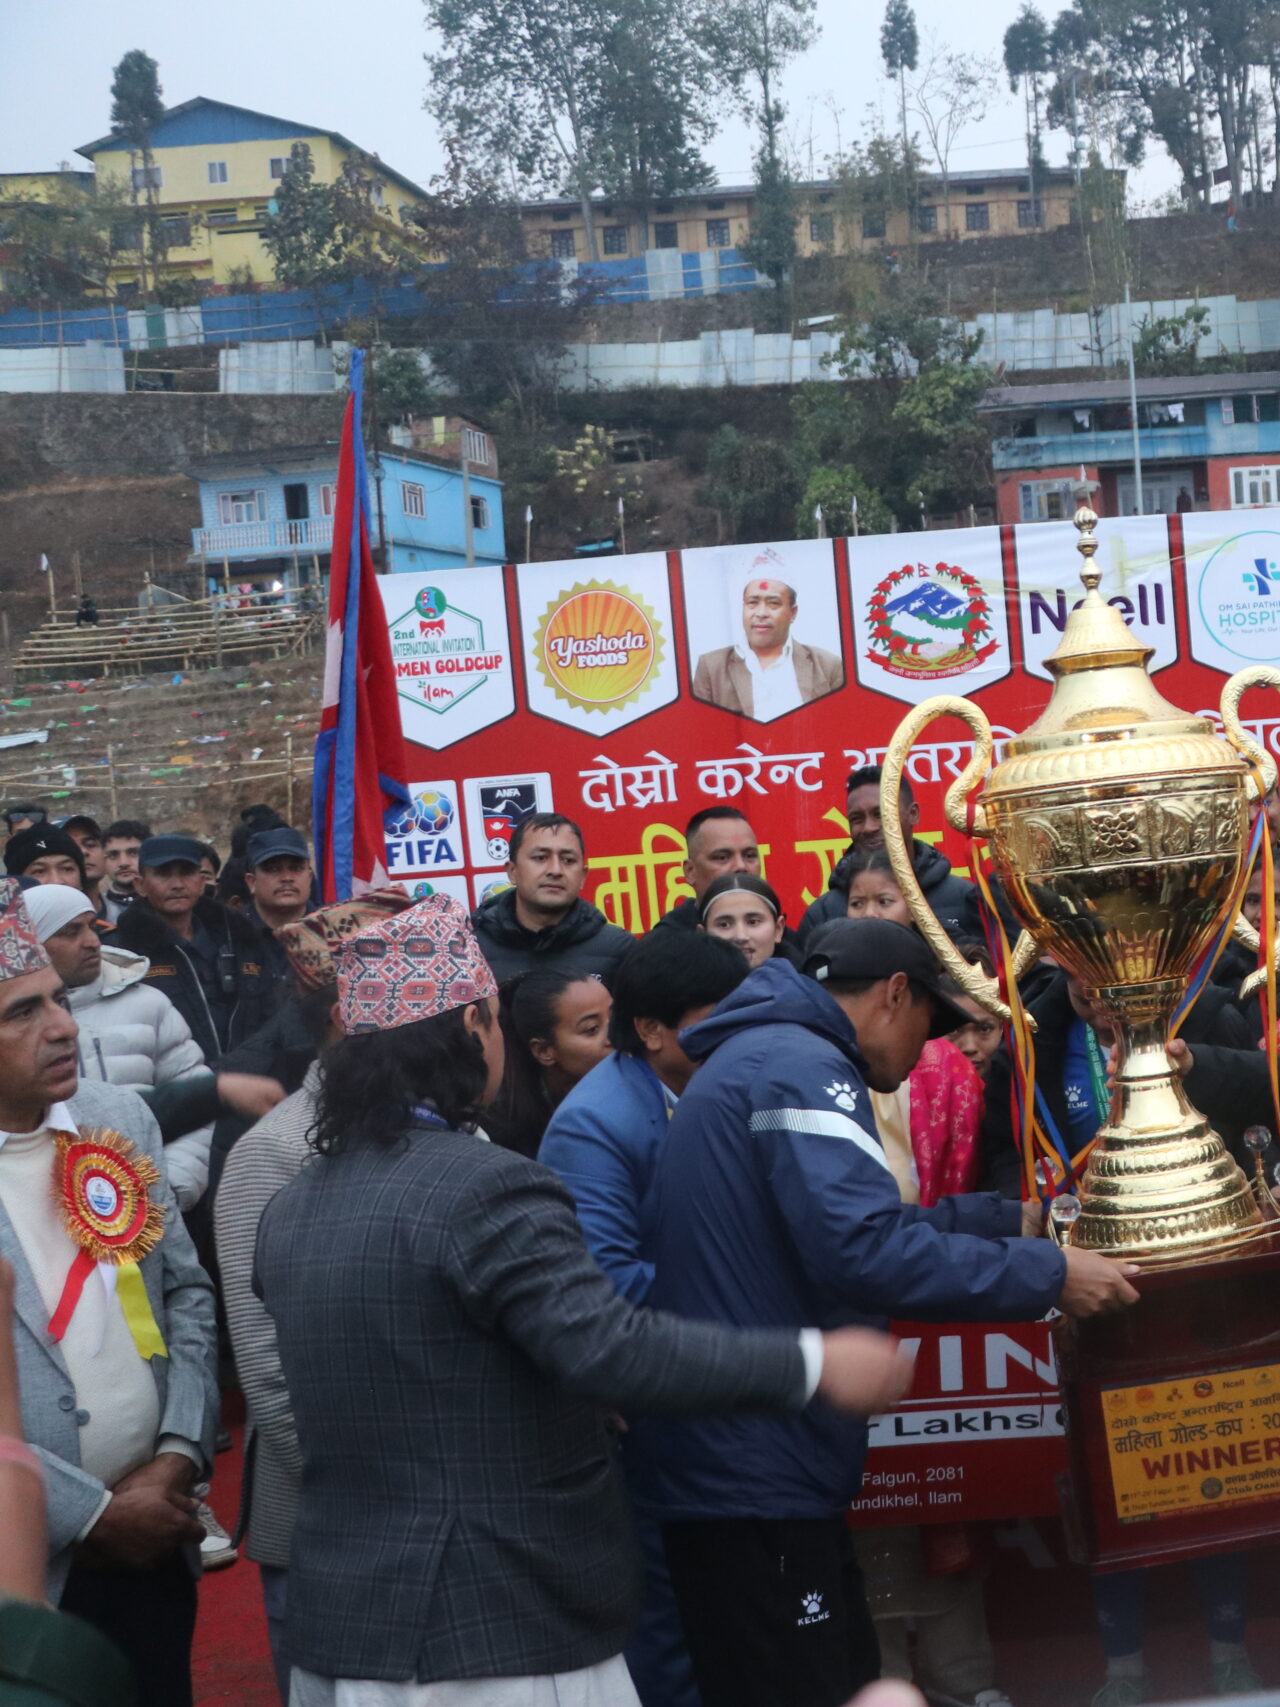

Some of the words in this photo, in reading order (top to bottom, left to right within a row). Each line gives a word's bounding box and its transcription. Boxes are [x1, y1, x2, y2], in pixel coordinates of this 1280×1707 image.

[1029, 583, 1166, 634] Nell
[1235, 602, 1250, 610] SAI
[394, 629, 415, 640] 2nd
[442, 638, 475, 652] INVITATION
[550, 630, 649, 668] Yashoda
[577, 651, 628, 668] FOODS
[395, 660, 431, 677] MEN
[435, 655, 502, 674] GOLDCUP
[578, 751, 678, 812] दोस्रो
[696, 743, 825, 798] करेन्ट
[495, 787, 521, 798] ANFA
[386, 838, 457, 867] FIFA
[1067, 1101, 1088, 1109] ELME
[894, 1410, 1040, 1437] Lakhs
[1113, 1428, 1163, 1454] महिला
[861, 1470, 921, 1488] Falgun,
[926, 1466, 965, 1482] 2081
[851, 1493, 924, 1511] undikhel,
[929, 1491, 962, 1505] Ilam
[797, 1610, 831, 1626] KELME
